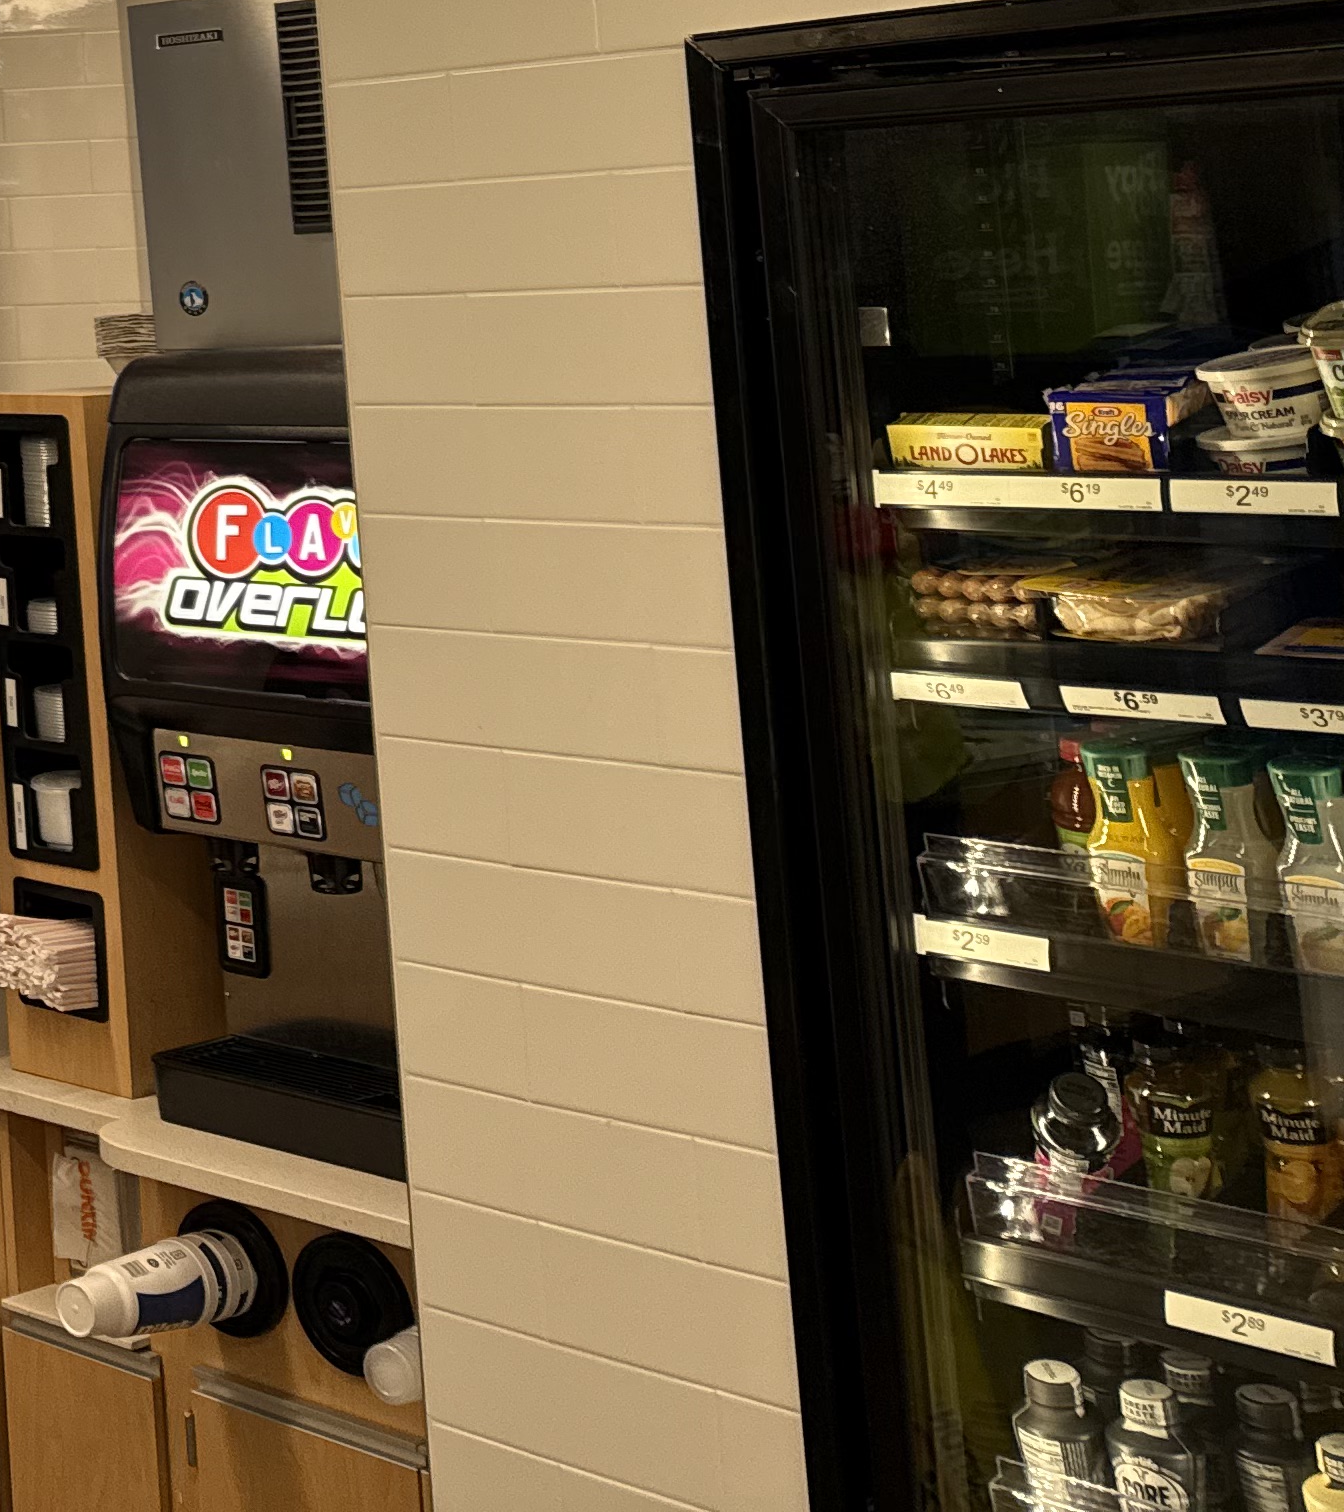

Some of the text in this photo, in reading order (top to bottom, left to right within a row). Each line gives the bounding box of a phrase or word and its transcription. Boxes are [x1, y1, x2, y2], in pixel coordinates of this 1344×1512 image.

[1222, 387, 1271, 406] Daisy
[1251, 406, 1296, 420] CREAM
[1062, 411, 1156, 445] Singles
[909, 443, 1028, 465] LAND O LAKES
[1218, 457, 1264, 474] Daisy
[1153, 1105, 1212, 1121] Minute
[1261, 1109, 1320, 1129] Minute
[1163, 1120, 1207, 1134] Maid
[1270, 1124, 1315, 1142] Maid
